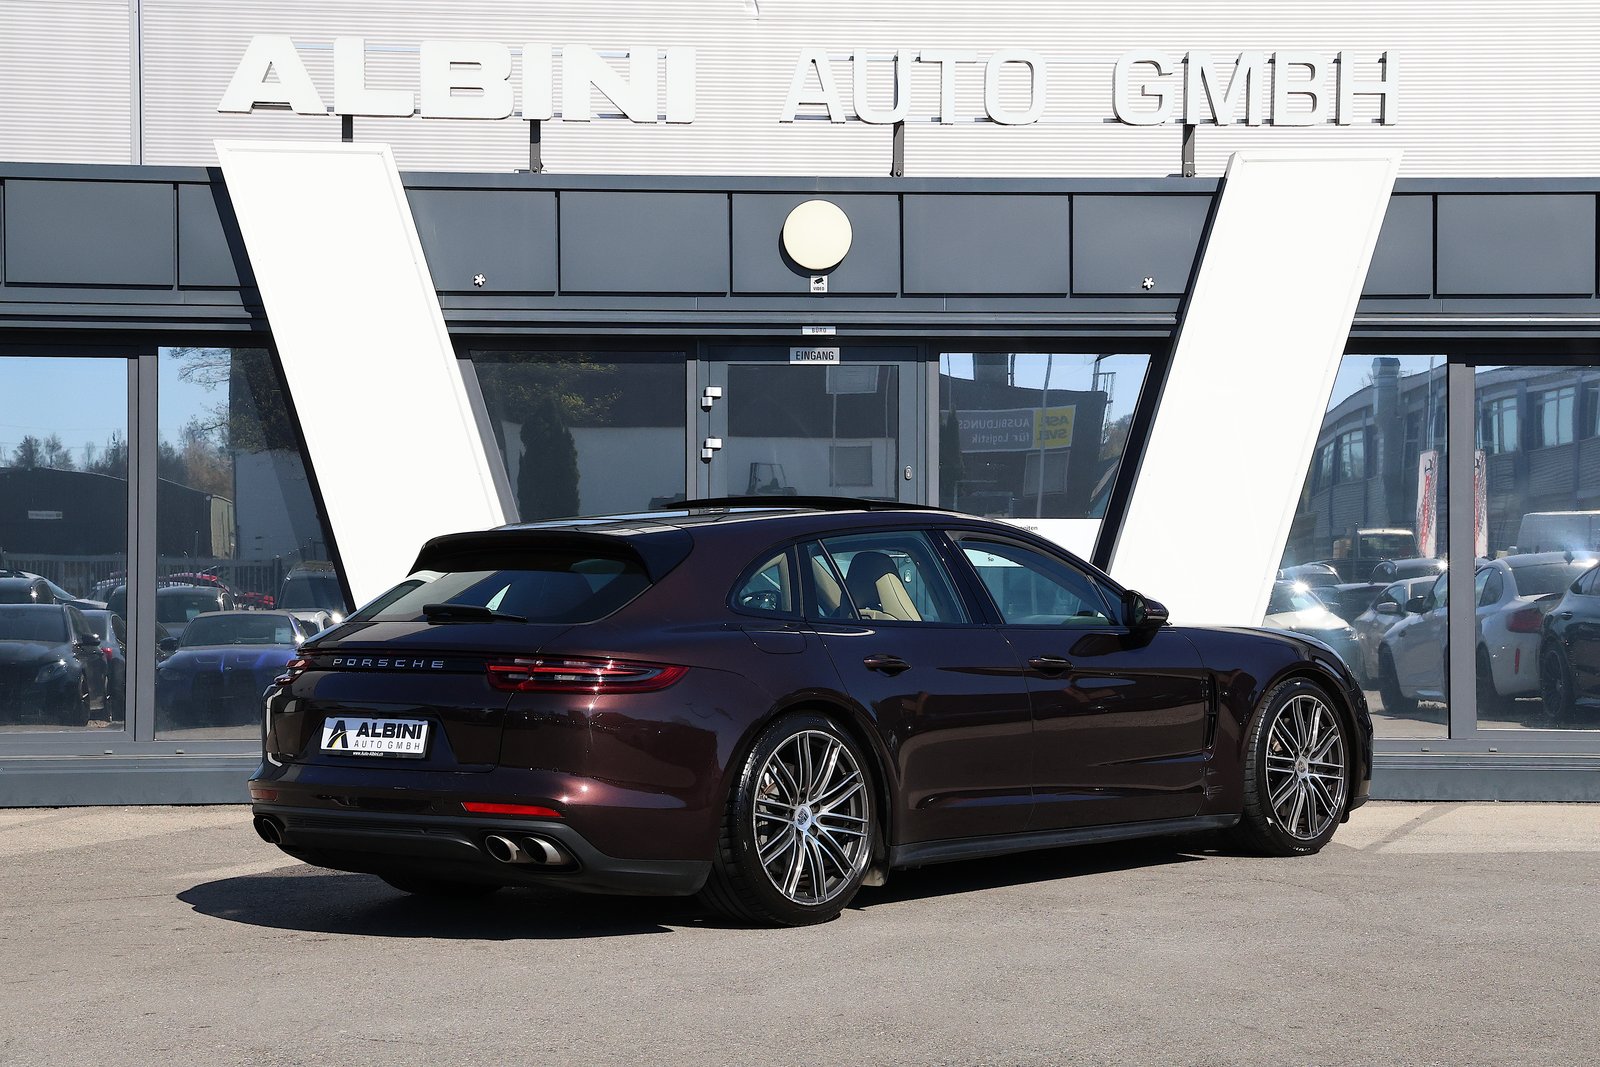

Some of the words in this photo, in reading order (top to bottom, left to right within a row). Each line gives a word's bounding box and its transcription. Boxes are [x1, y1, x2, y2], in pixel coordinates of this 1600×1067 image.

[217, 35, 696, 124] ALBINI
[779, 47, 1047, 126] AUTO
[1112, 50, 1398, 127] GMBH
[795, 350, 834, 361] EINGANG
[333, 659, 444, 668] PORSCHE
[356, 722, 422, 739] ALBINI
[354, 740, 382, 748] AUTO
[387, 741, 421, 750] GMBH
